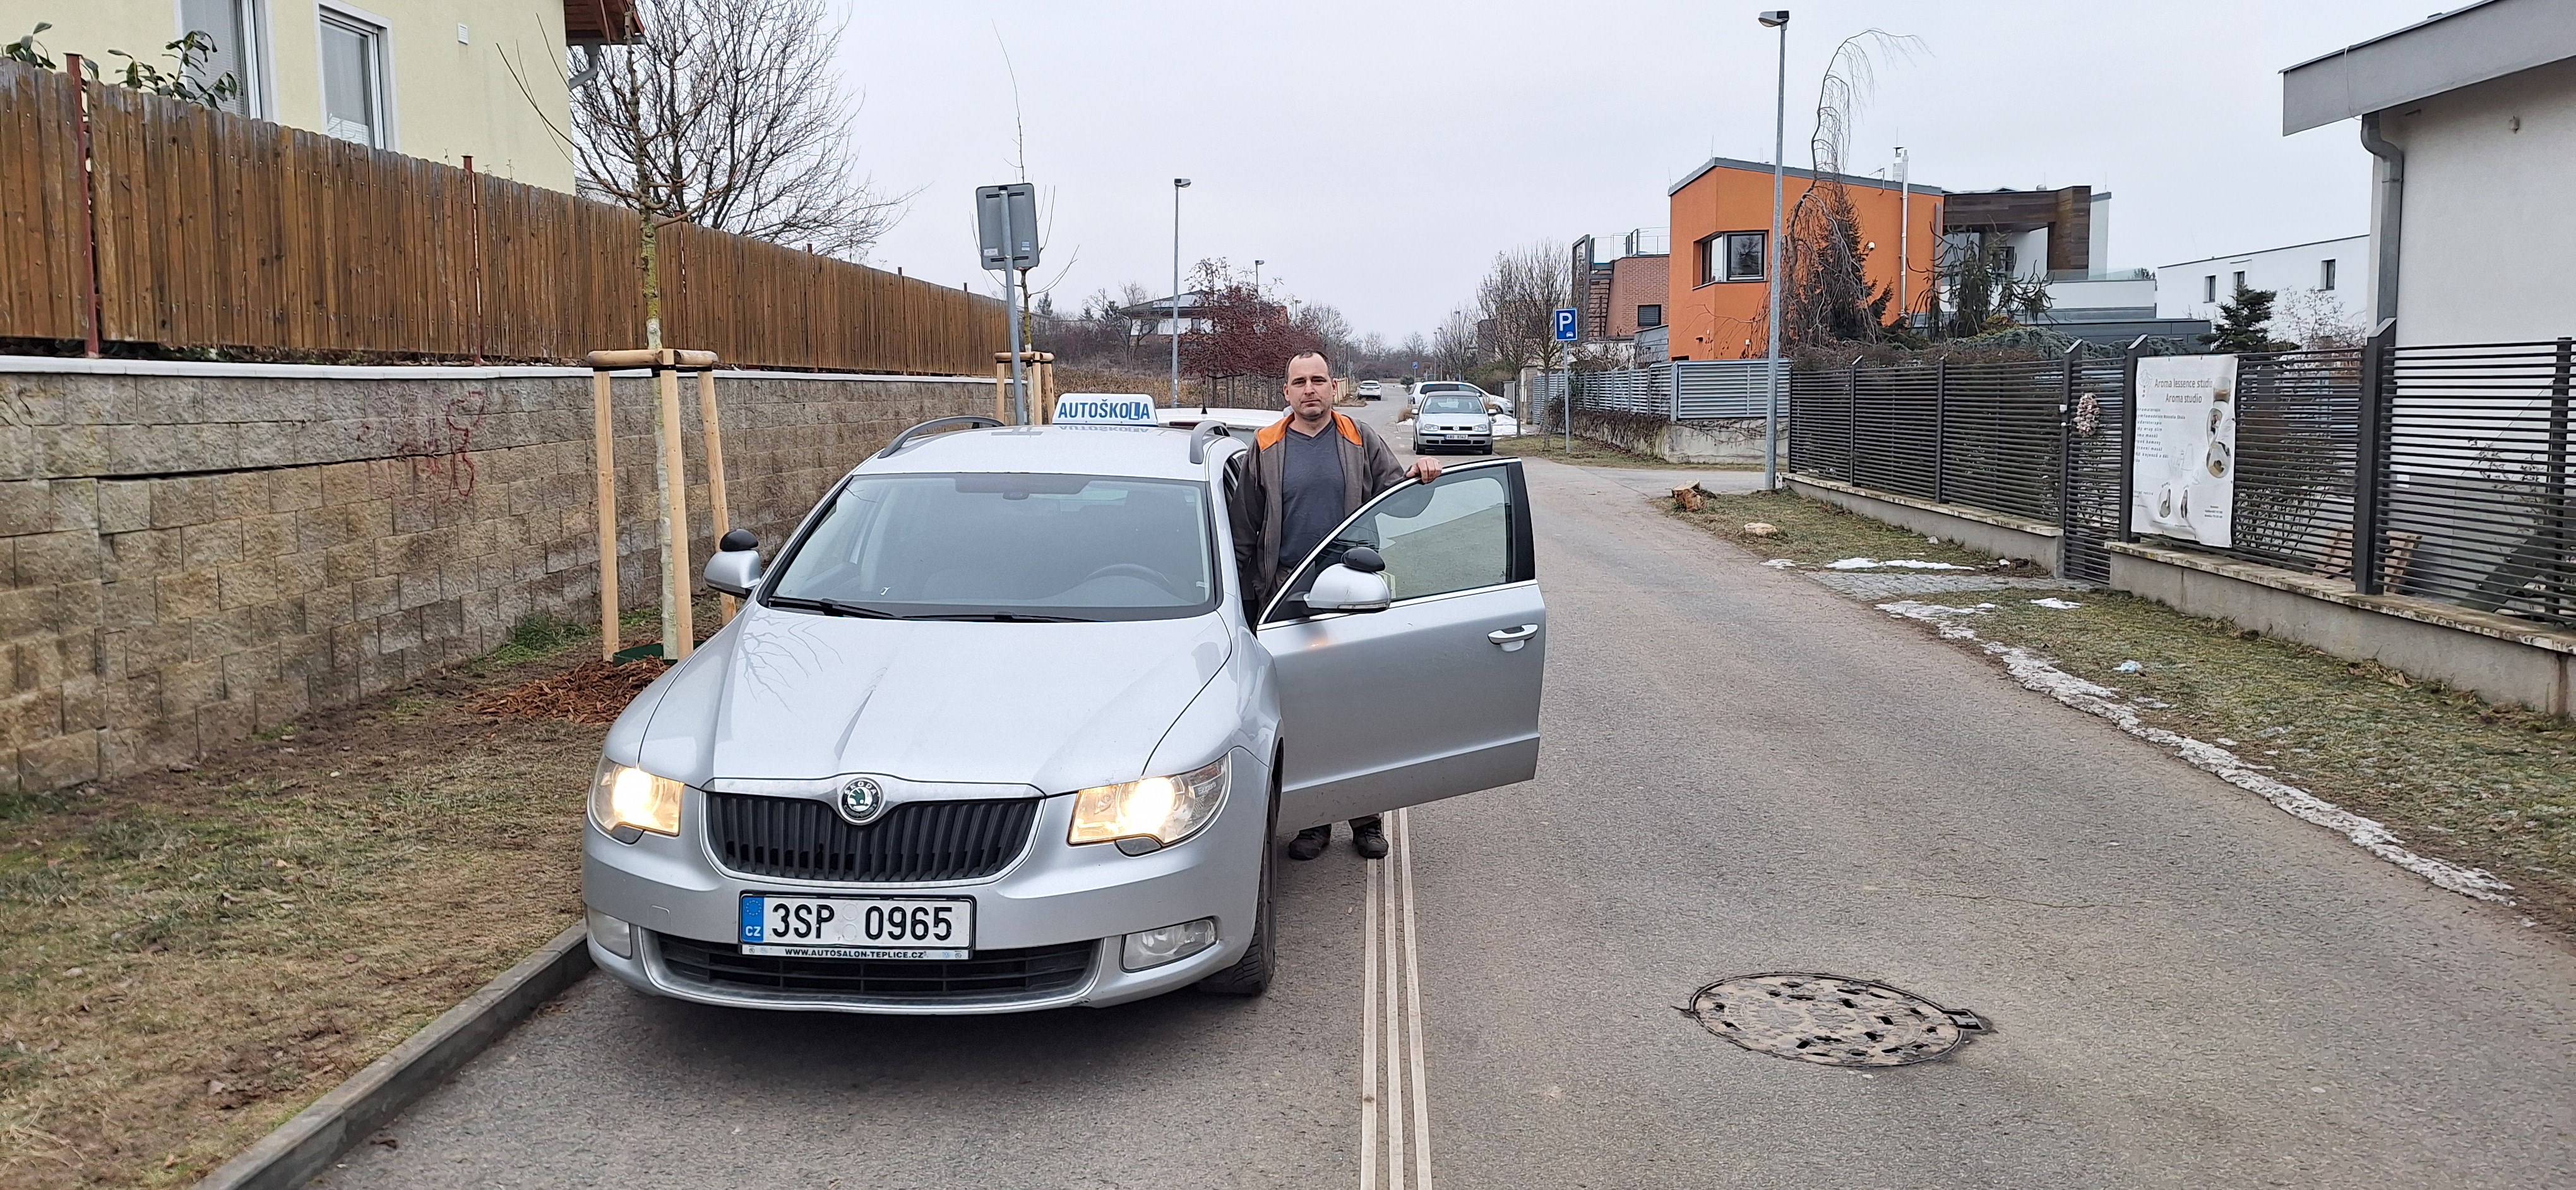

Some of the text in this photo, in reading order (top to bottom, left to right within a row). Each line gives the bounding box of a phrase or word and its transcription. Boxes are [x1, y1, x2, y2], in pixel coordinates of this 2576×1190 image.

[1559, 313, 1572, 331] P
[2155, 379, 2172, 388] Aroma
[2166, 394, 2202, 403] Aroma studio
[1058, 399, 1150, 420] AUTOŠKOLA
[772, 903, 953, 941] 3SP 0965
[745, 925, 761, 937] CZ
[785, 948, 924, 959] WWW.AUTOSALON-TEPLICE.CZ
